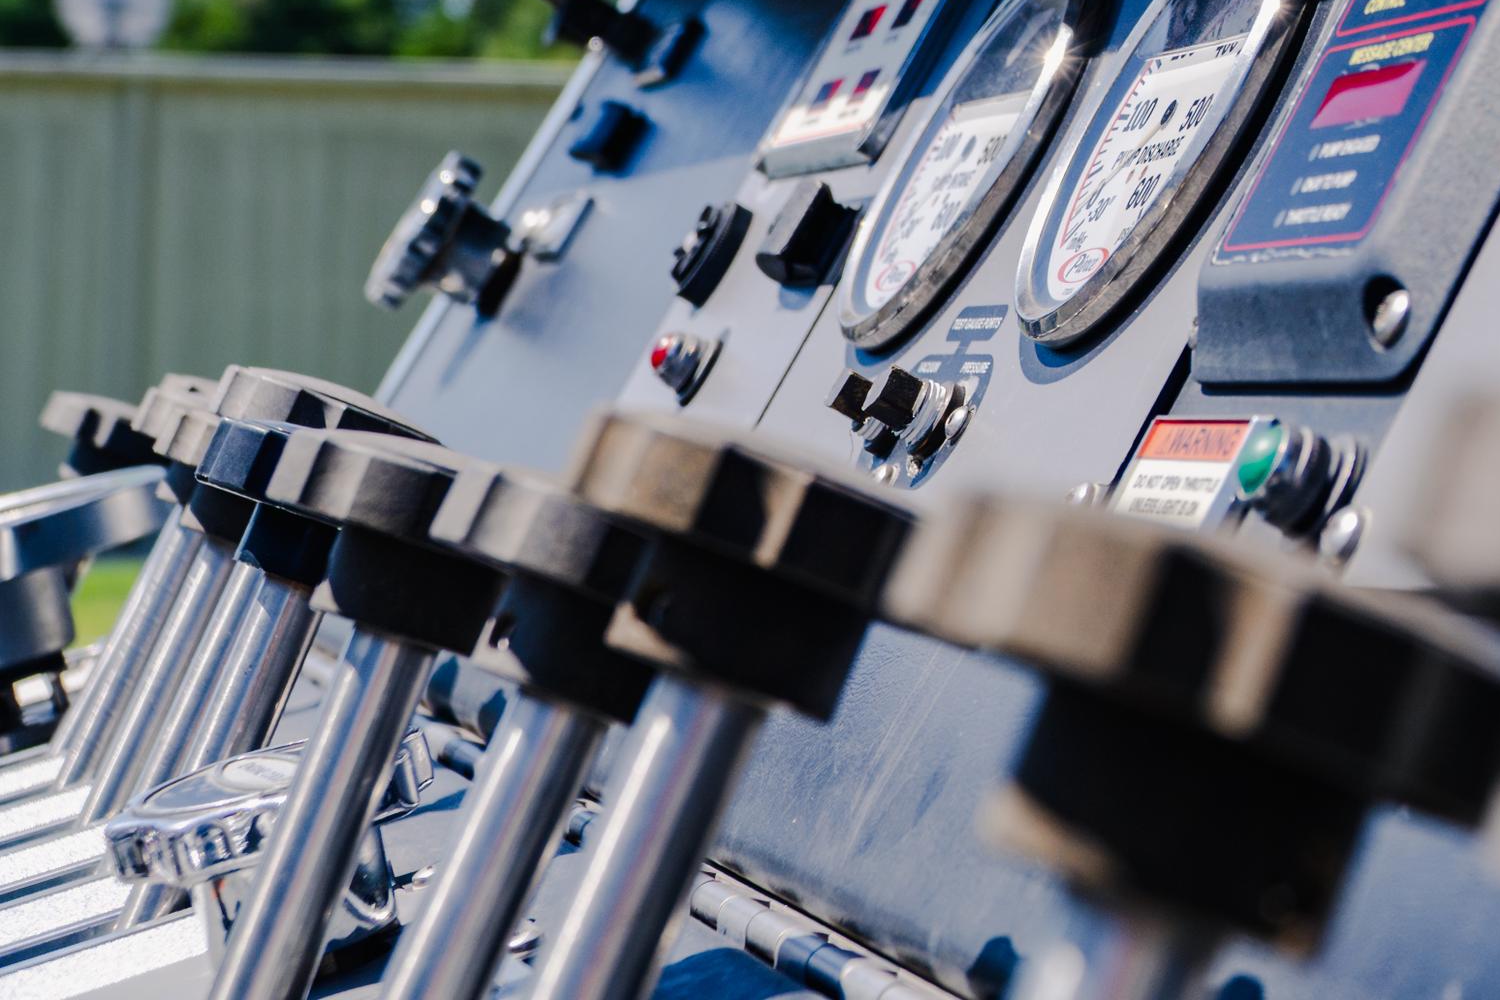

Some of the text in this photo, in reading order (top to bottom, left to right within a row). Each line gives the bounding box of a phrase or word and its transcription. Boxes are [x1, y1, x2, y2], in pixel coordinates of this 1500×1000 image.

[1122, 93, 1215, 133] 100 500
[1136, 135, 1186, 166] DISCHARGE
[1126, 173, 1162, 210] 600
